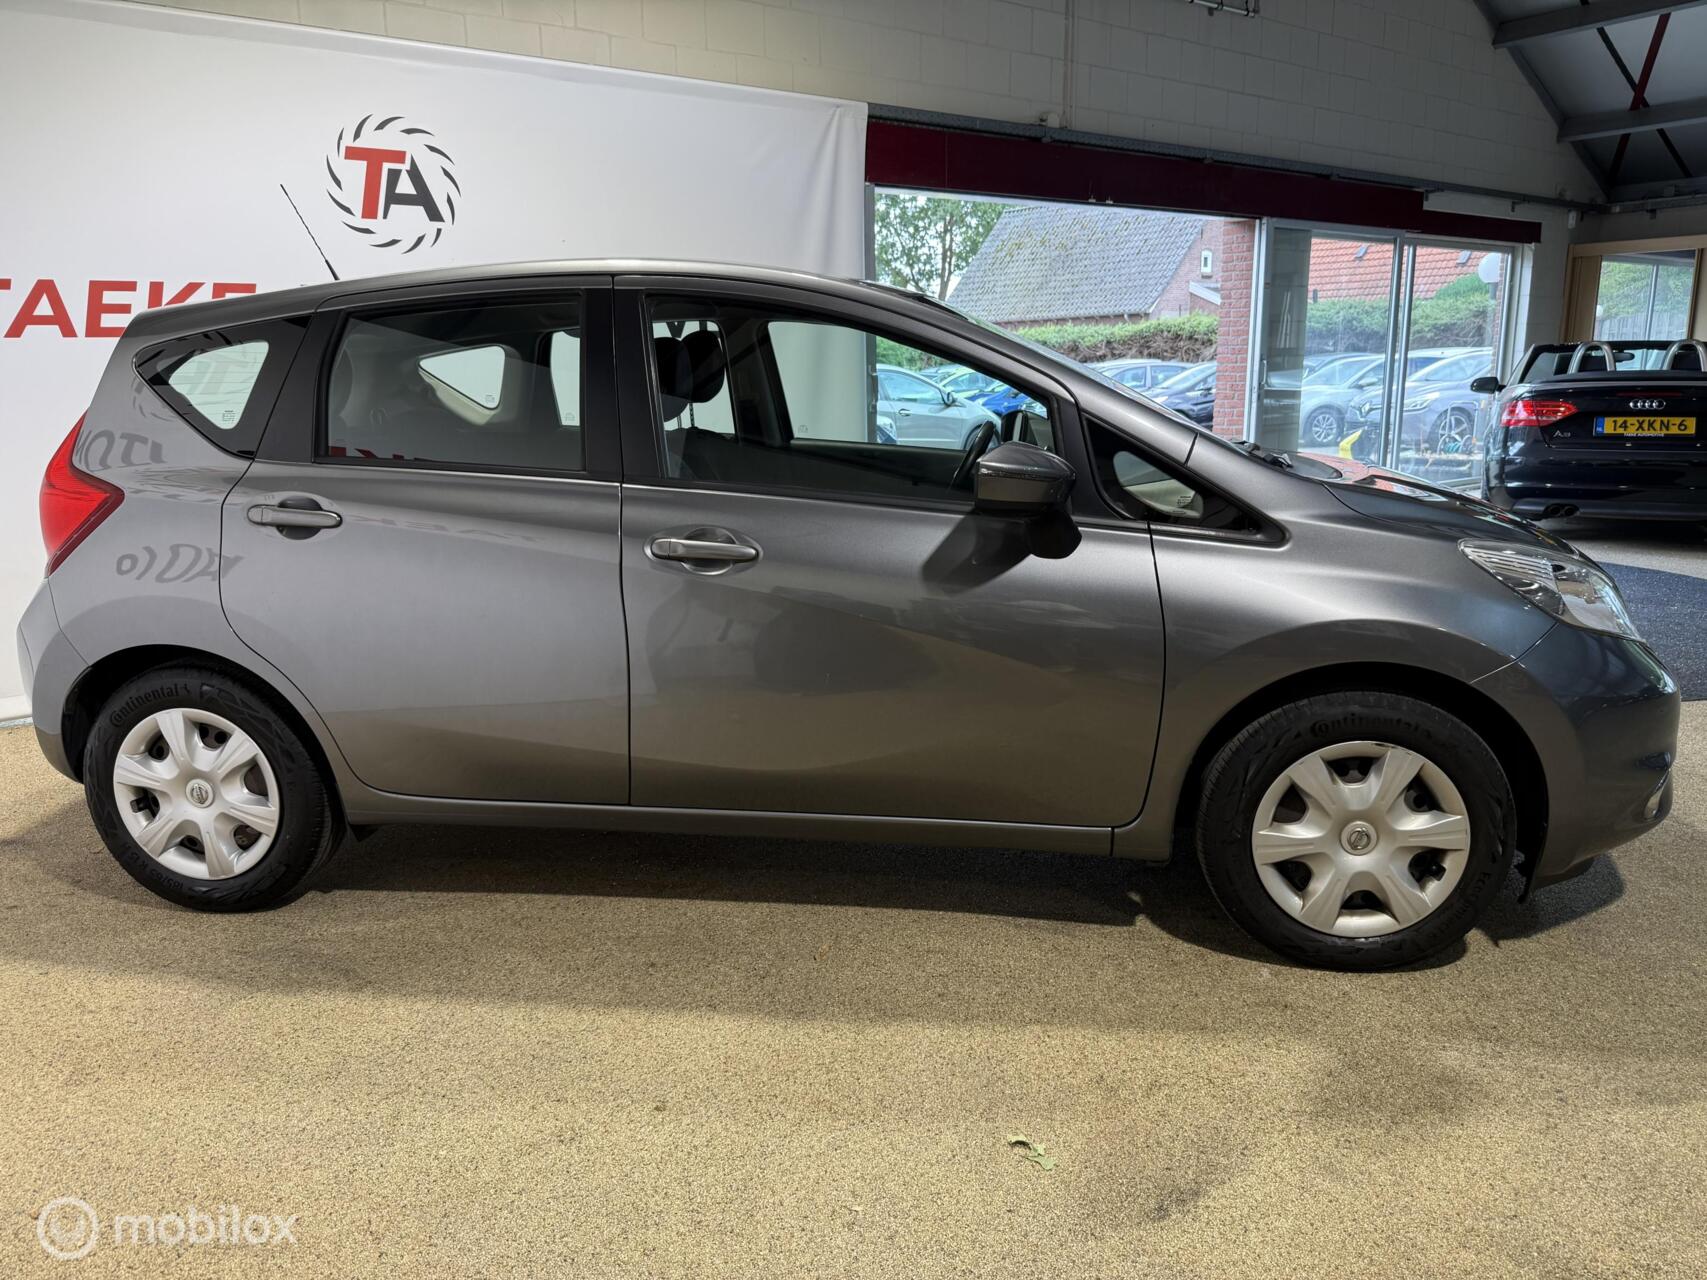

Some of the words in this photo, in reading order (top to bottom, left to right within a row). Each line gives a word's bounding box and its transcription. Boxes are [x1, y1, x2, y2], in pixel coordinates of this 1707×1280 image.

[344, 145, 446, 223] TA
[1612, 418, 1688, 432] 14-XKN-6
[109, 682, 180, 728] Continental
